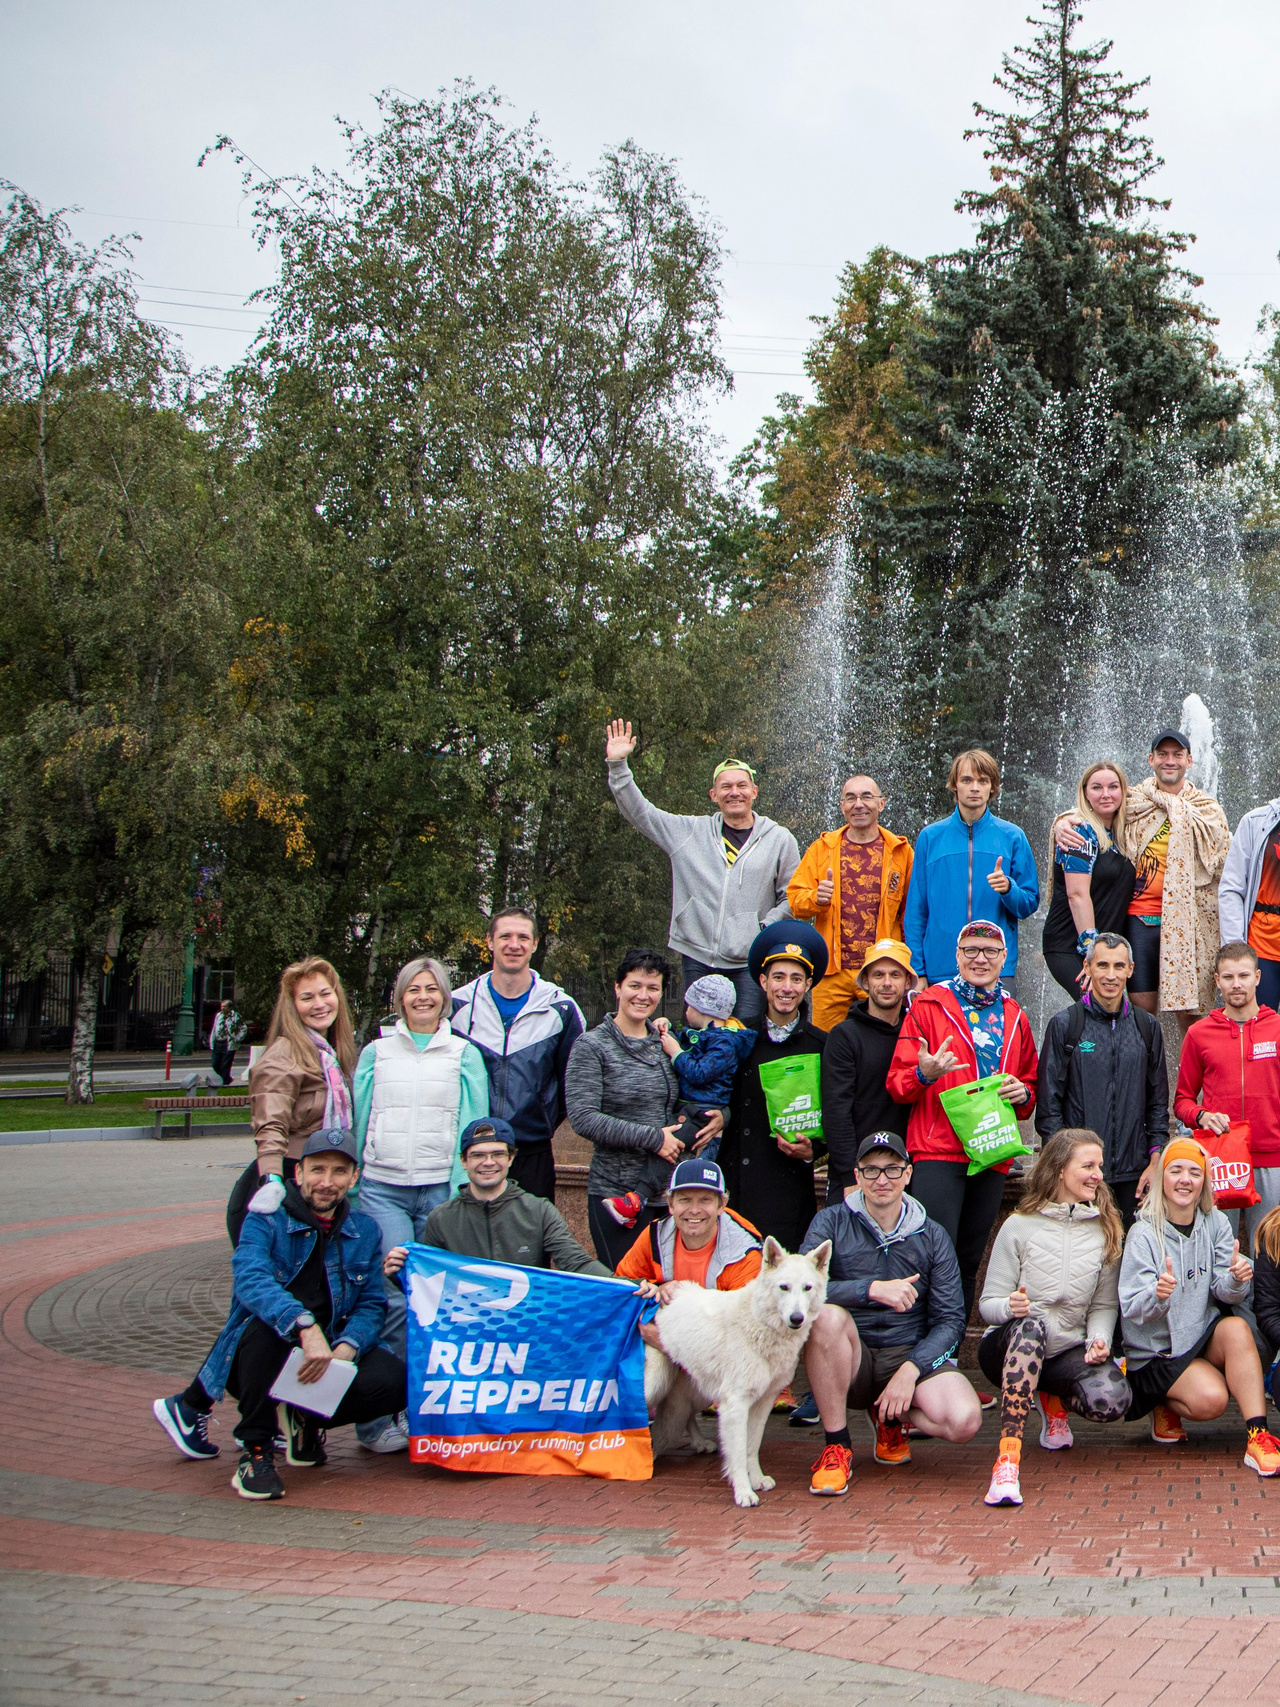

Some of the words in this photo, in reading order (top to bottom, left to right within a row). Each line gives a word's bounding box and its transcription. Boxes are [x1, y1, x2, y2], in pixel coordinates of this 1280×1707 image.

[775, 1109, 822, 1126] DREAM
[781, 1118, 821, 1134] TRAIL
[968, 1122, 1016, 1148] DREAM
[976, 1133, 1017, 1154] TRAIL
[426, 1340, 530, 1376] RUN
[417, 1437, 524, 1458] Dolgoprudny
[530, 1435, 586, 1456] running
[589, 1433, 627, 1451] club
